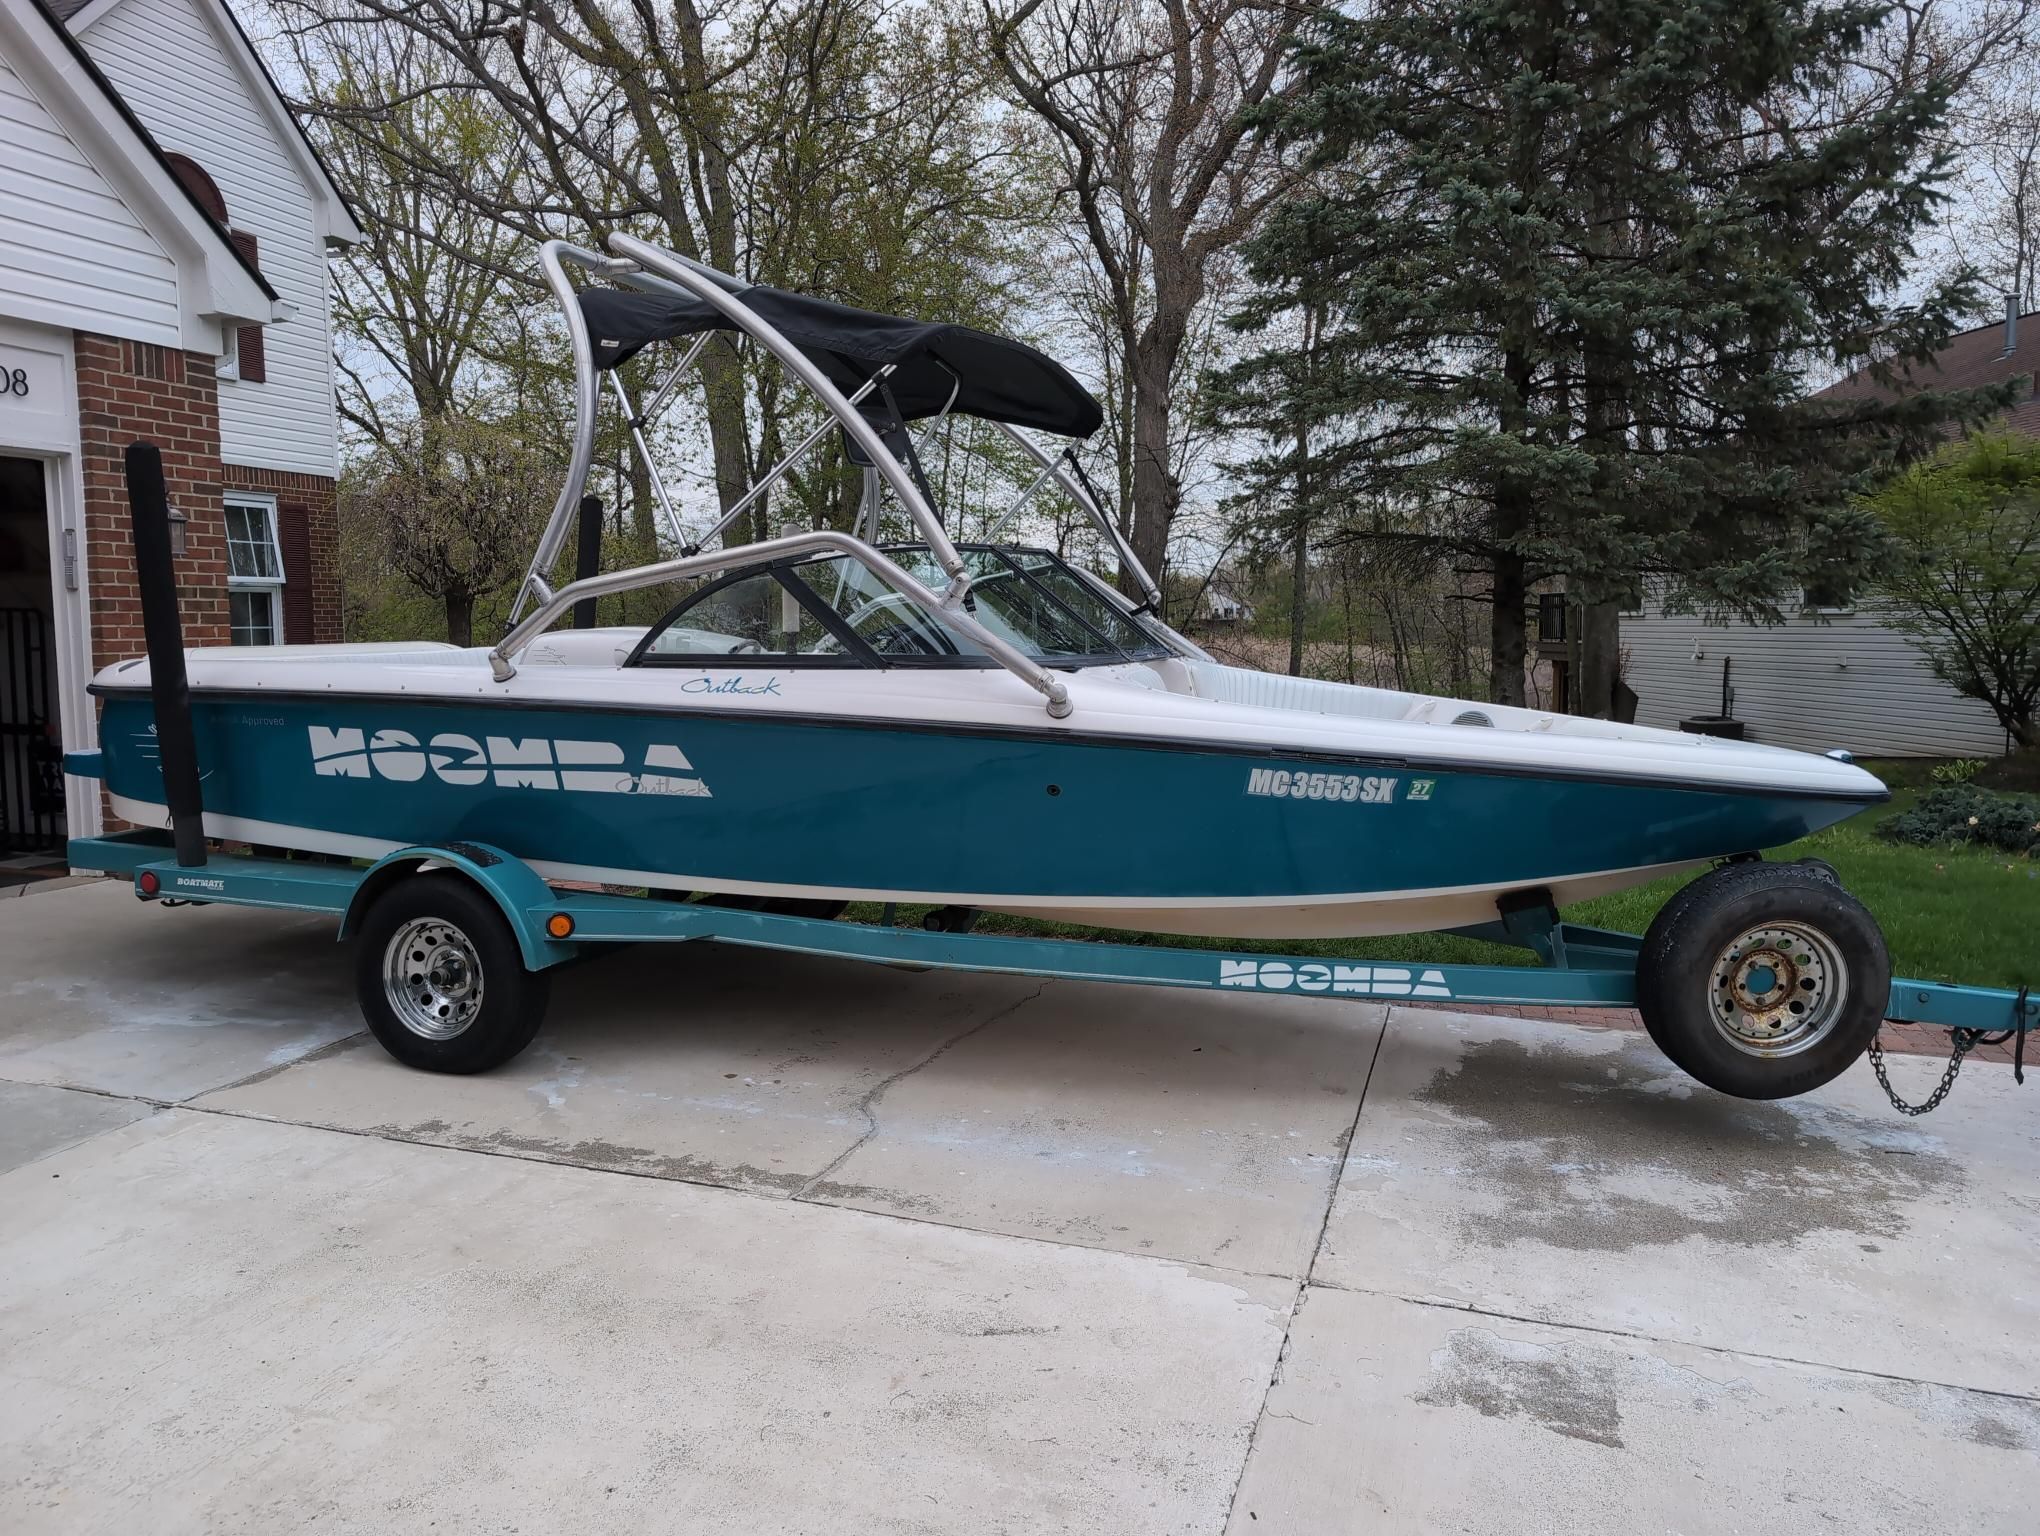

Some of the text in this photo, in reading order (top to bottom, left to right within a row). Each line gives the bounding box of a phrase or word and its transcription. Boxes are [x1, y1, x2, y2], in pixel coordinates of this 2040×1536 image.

[680, 676, 781, 696] Outback
[241, 714, 285, 726] Approved
[307, 725, 713, 798] MOOMBA
[1411, 783, 1430, 795] 27
[177, 877, 225, 888] BOATMATE
[1220, 959, 1451, 997] MOOMBA
